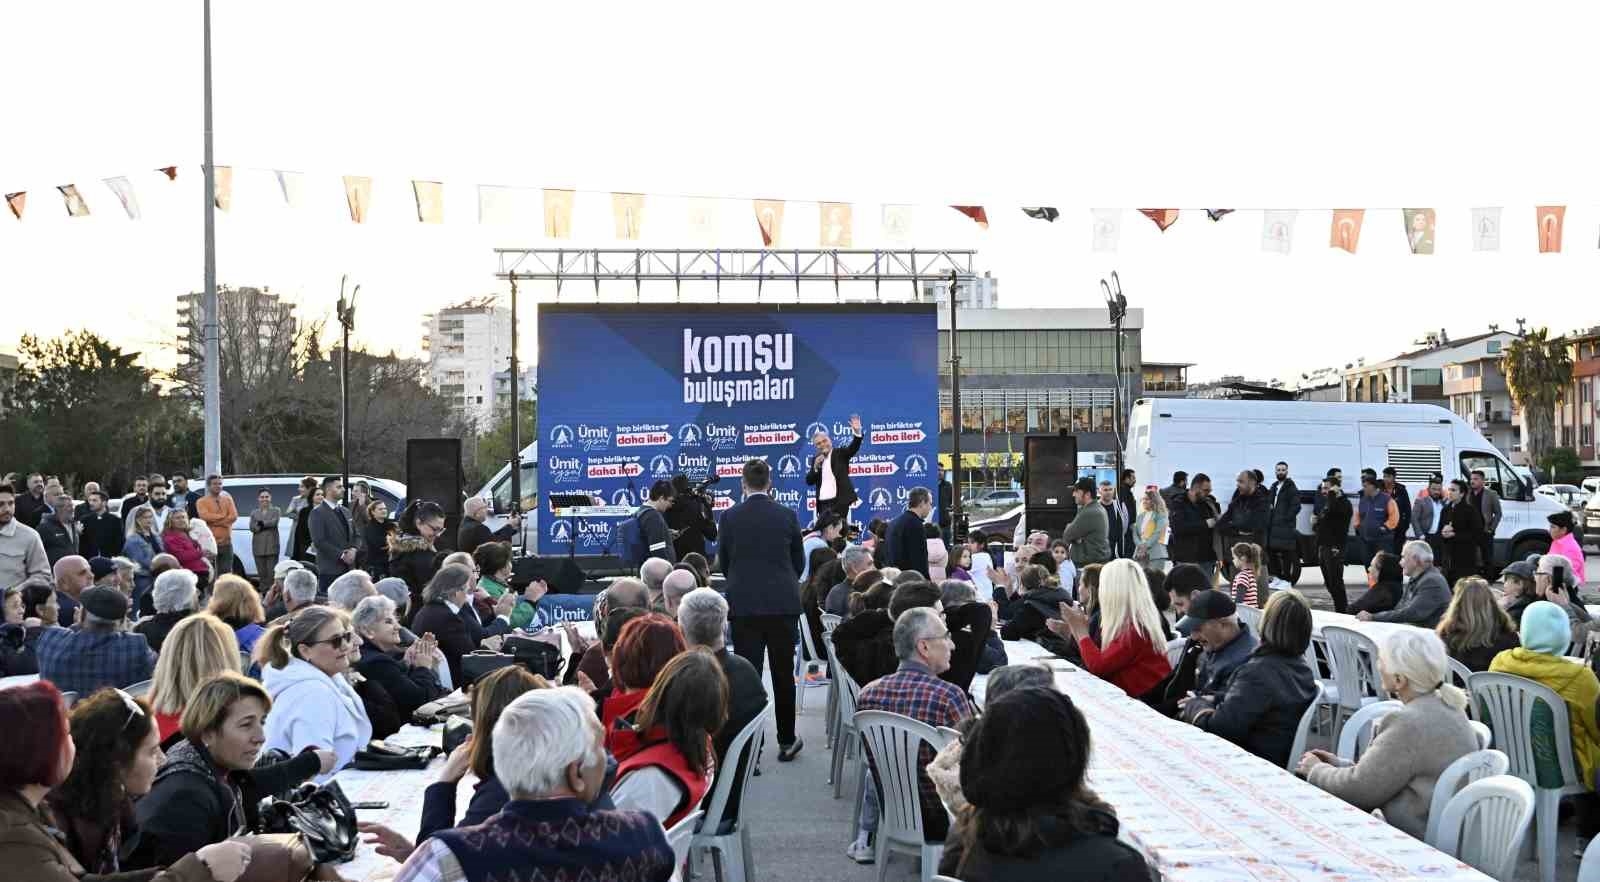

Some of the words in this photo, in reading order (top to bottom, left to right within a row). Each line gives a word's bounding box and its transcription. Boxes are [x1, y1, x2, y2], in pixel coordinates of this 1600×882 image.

[683, 328, 793, 374] komşu
[683, 373, 794, 407] buluşmaları
[578, 424, 608, 438] Ümit
[616, 425, 631, 433] hep
[632, 424, 659, 432] birlikte
[706, 422, 736, 437] Ümit
[744, 424, 759, 432] hep
[760, 423, 787, 431] birlikte
[871, 423, 885, 431] hep
[886, 422, 914, 430] birlikte
[617, 435, 646, 445] daha
[647, 433, 667, 443] ileri
[745, 434, 772, 444] daha
[774, 432, 794, 442] ileri
[872, 433, 899, 443] daha
[900, 431, 920, 441] ileri
[550, 456, 580, 470] Ümit
[587, 456, 603, 464] hep
[678, 452, 708, 467] Ümit
[716, 456, 731, 464] hep
[589, 466, 616, 476] daha
[873, 464, 893, 473] ileri
[578, 519, 608, 533] Ümit
[553, 605, 586, 621] Ümit
